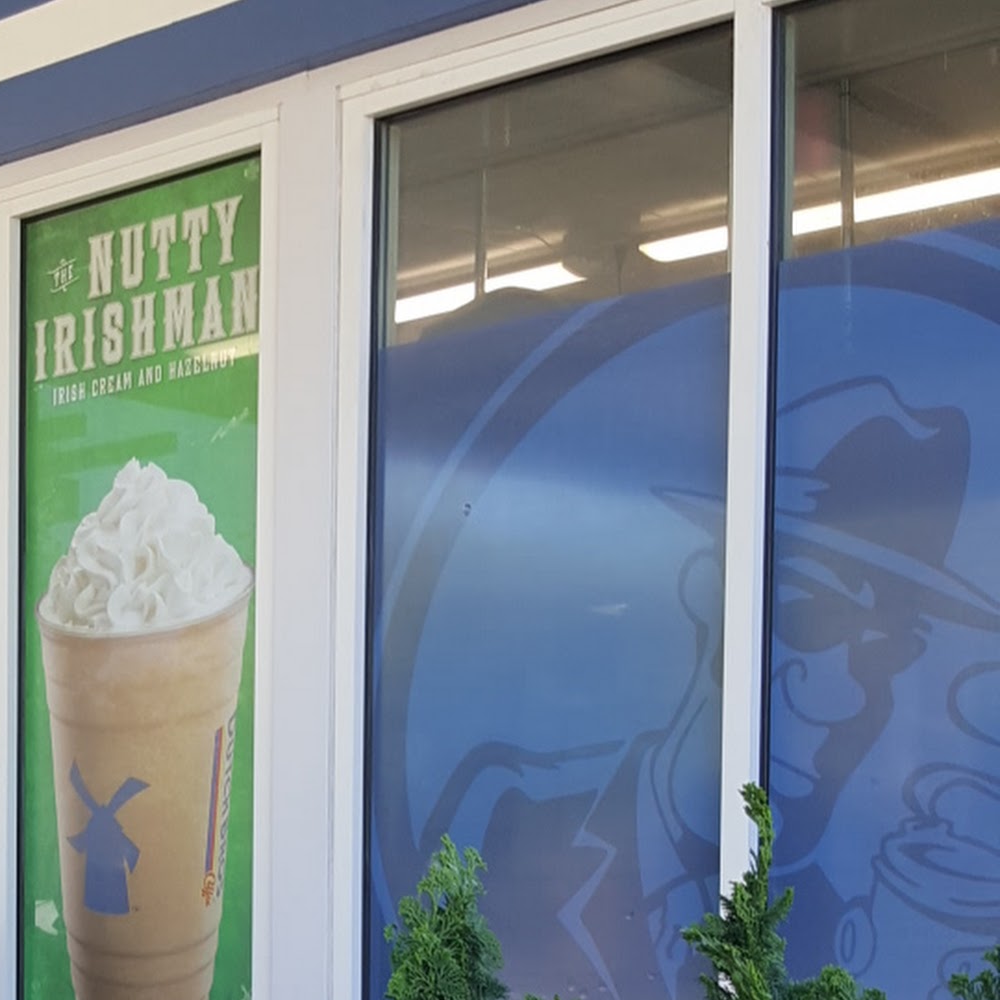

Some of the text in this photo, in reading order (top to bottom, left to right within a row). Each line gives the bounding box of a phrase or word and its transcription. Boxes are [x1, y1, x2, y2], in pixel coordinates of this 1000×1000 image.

[52, 195, 243, 299] THE NUTTY
[34, 265, 260, 383] IRISHMAN
[52, 347, 237, 407] IRISH CREAM AND HAZELNUT
